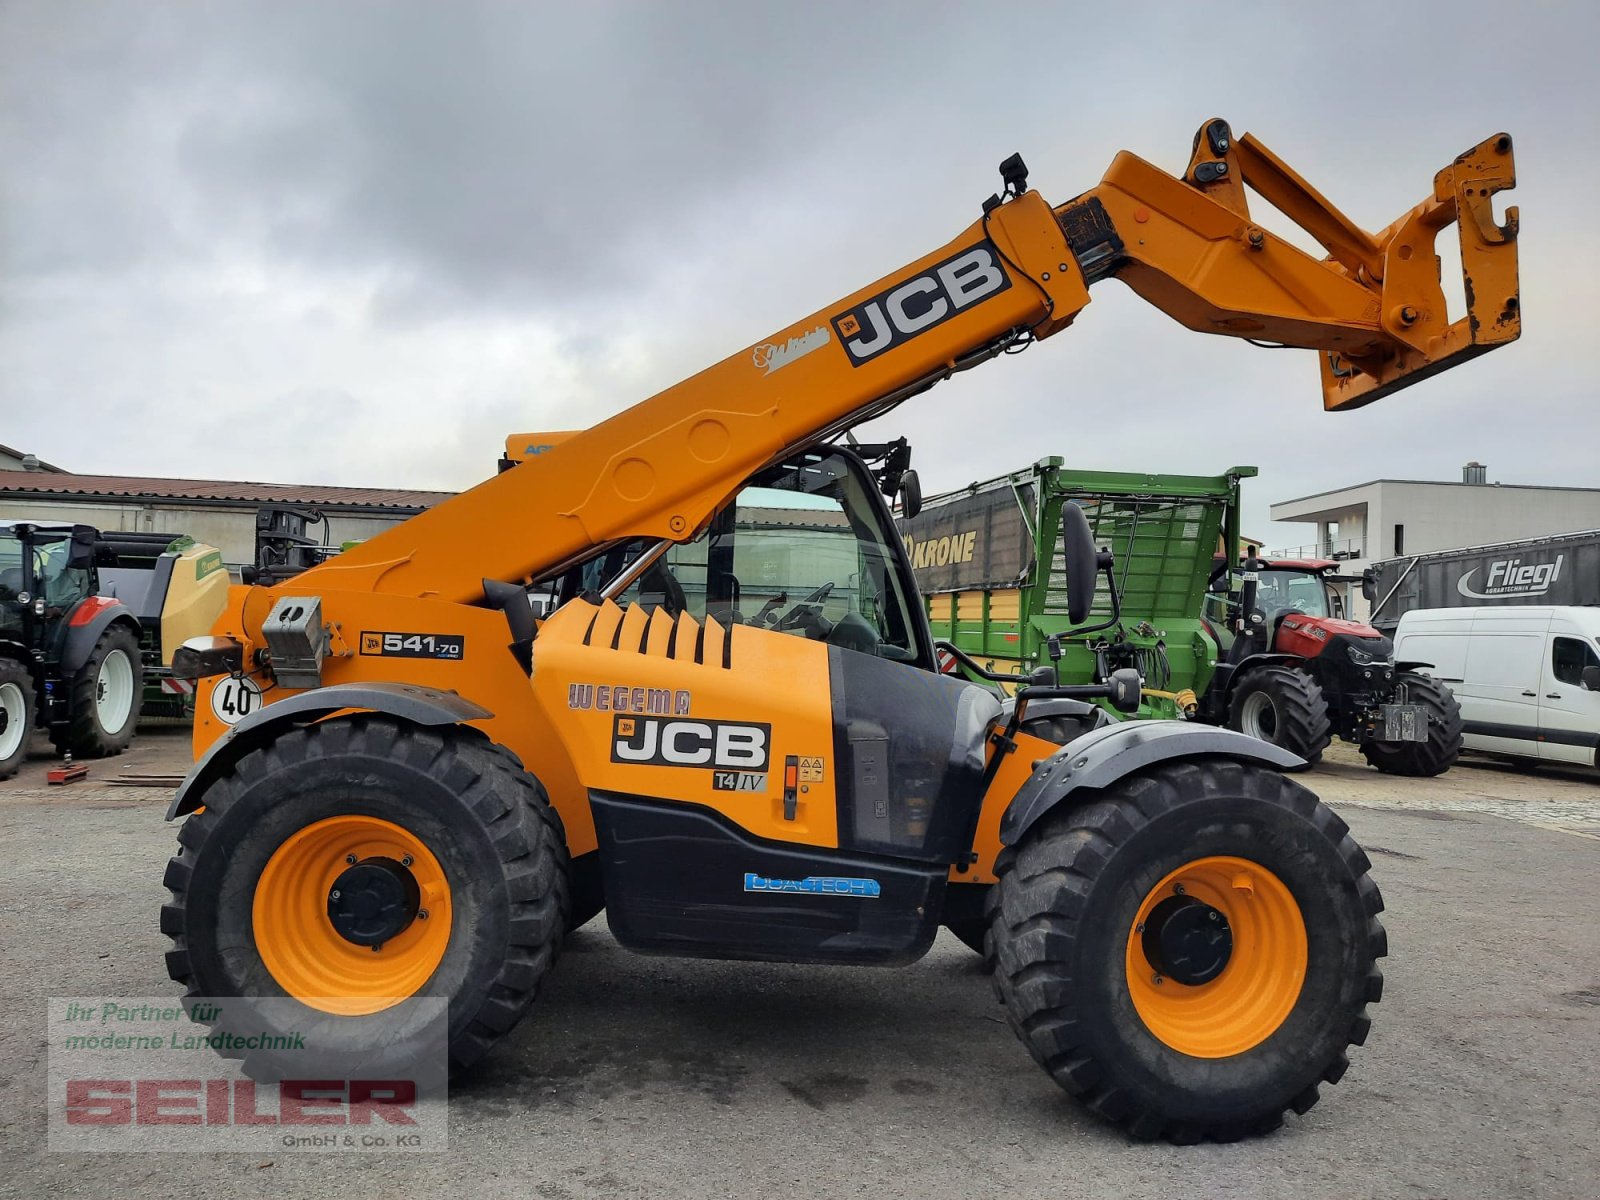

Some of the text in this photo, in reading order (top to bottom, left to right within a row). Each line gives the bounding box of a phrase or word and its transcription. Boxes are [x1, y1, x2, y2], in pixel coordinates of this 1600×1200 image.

[848, 249, 1003, 358] JCB
[913, 530, 977, 570] KRONE
[1486, 554, 1564, 591] Fliegl
[222, 685, 251, 716] 40
[567, 683, 690, 715] WEGEMA
[616, 720, 765, 768] JCB
[715, 773, 735, 789] T4
